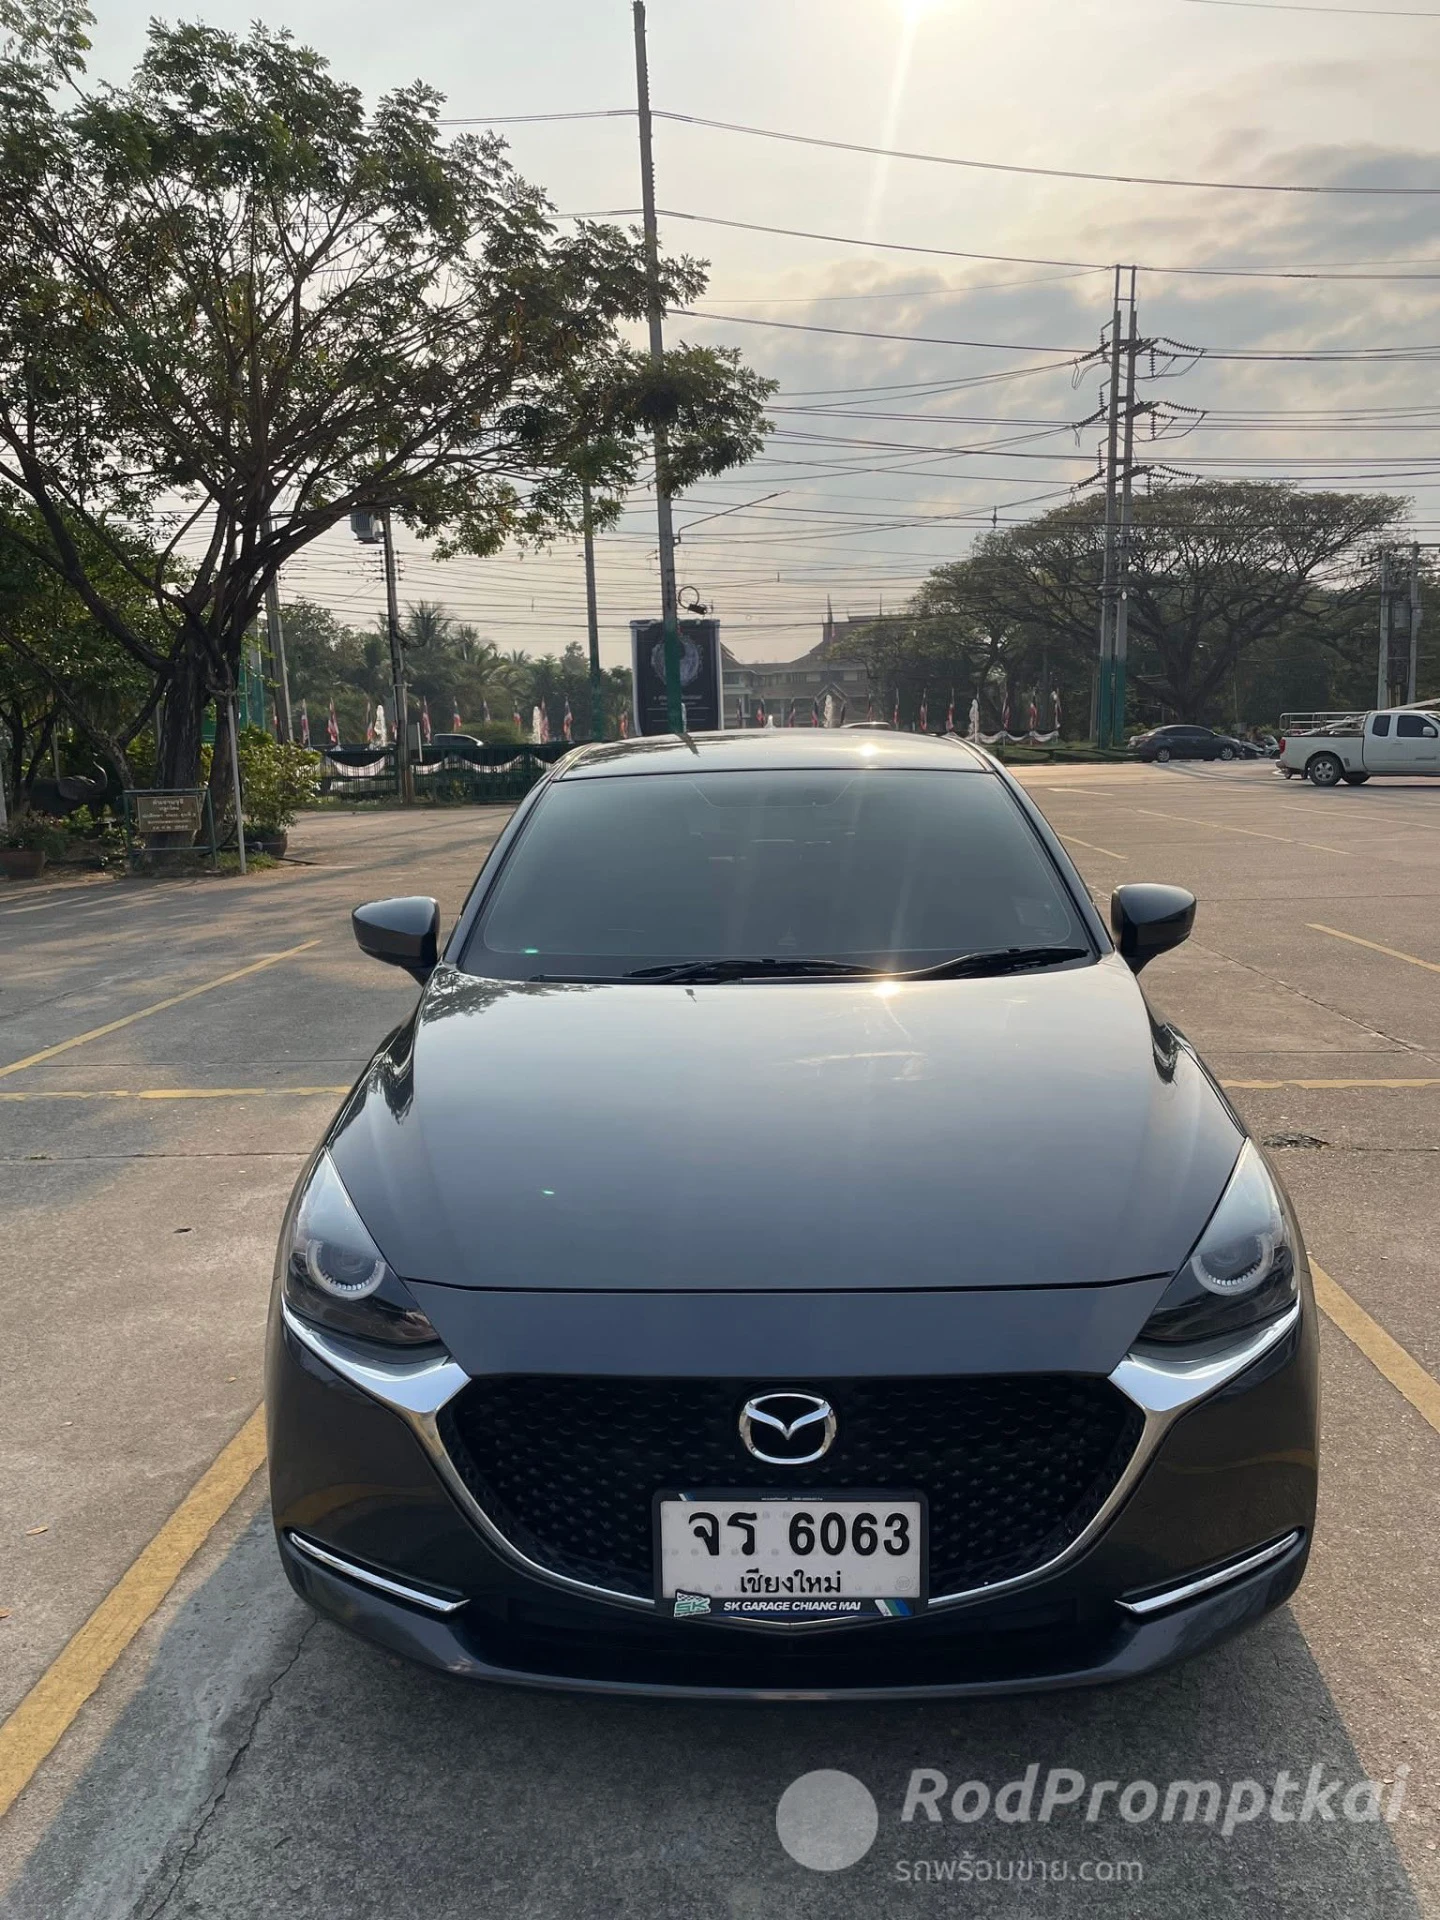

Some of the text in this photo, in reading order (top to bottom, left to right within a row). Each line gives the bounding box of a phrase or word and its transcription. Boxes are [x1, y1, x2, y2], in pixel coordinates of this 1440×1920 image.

[688, 1512, 910, 1556] จร 6063
[740, 1567, 842, 1593] เชียงใหม่
[723, 1601, 741, 1612] SK
[742, 1601, 790, 1612] GARAGE
[791, 1601, 837, 1612] CHIANG
[838, 1601, 861, 1612] MAI
